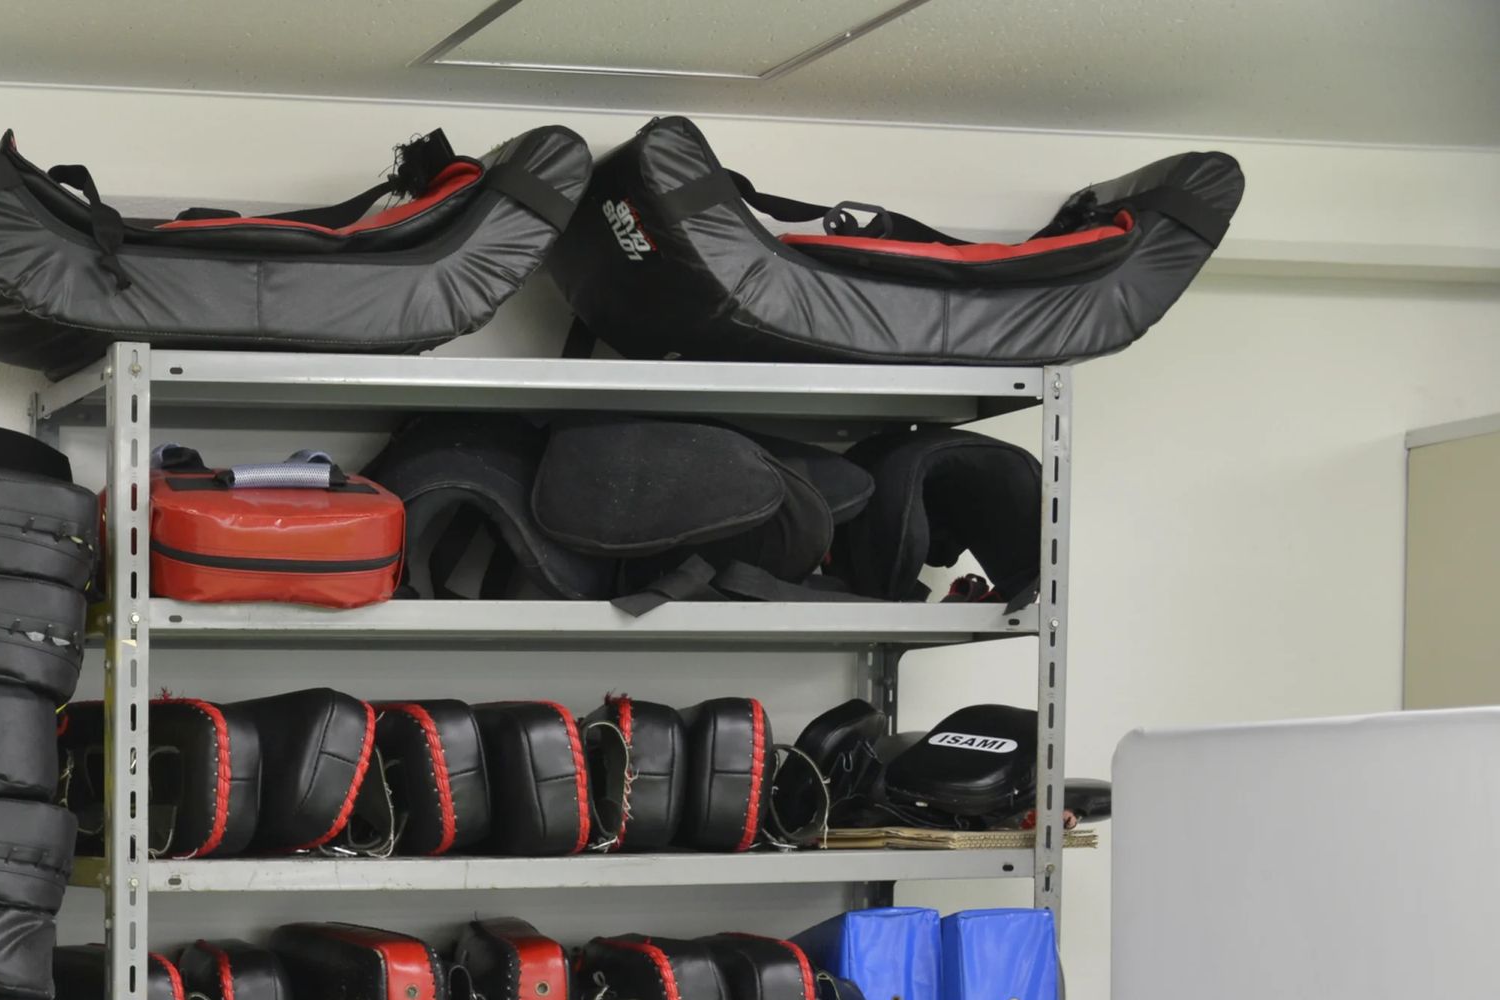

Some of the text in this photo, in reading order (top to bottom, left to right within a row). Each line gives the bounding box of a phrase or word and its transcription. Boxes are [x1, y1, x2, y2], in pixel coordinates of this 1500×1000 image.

[602, 199, 643, 260] LOTUS
[616, 200, 651, 252] CLUB
[938, 734, 1007, 750] ISAMI
